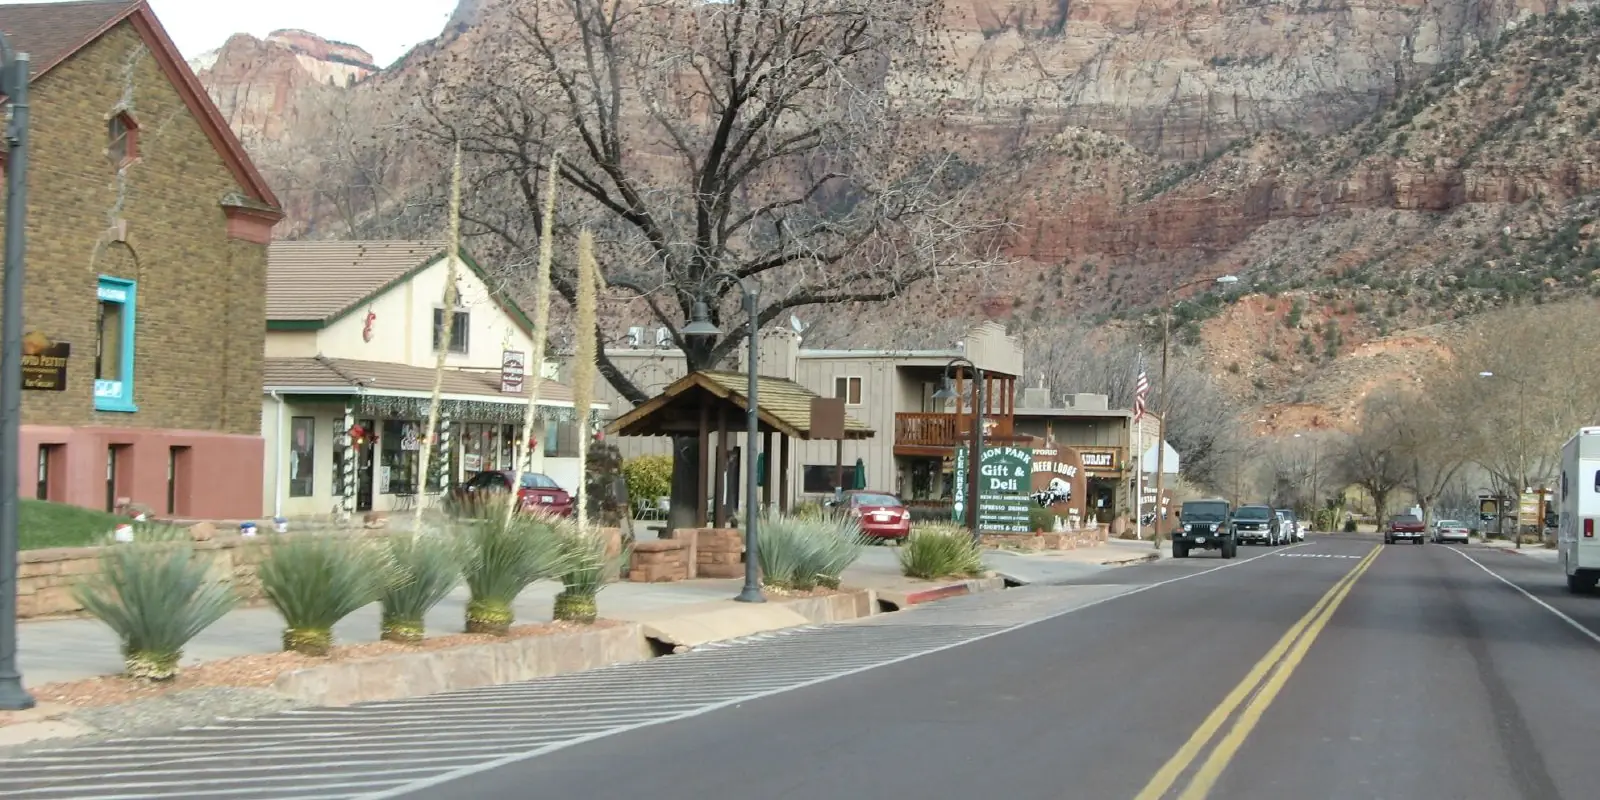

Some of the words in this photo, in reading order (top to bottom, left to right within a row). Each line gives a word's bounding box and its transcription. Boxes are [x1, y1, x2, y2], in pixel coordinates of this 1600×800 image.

[21, 355, 40, 366] AVID
[1005, 447, 1032, 464] PARK
[981, 464, 1009, 476] Gift
[1014, 466, 1025, 477] &
[1031, 460, 1052, 473] NEER
[1053, 462, 1078, 478] LODGE
[955, 470, 964, 502] CREAM
[990, 478, 1018, 491] Deli
